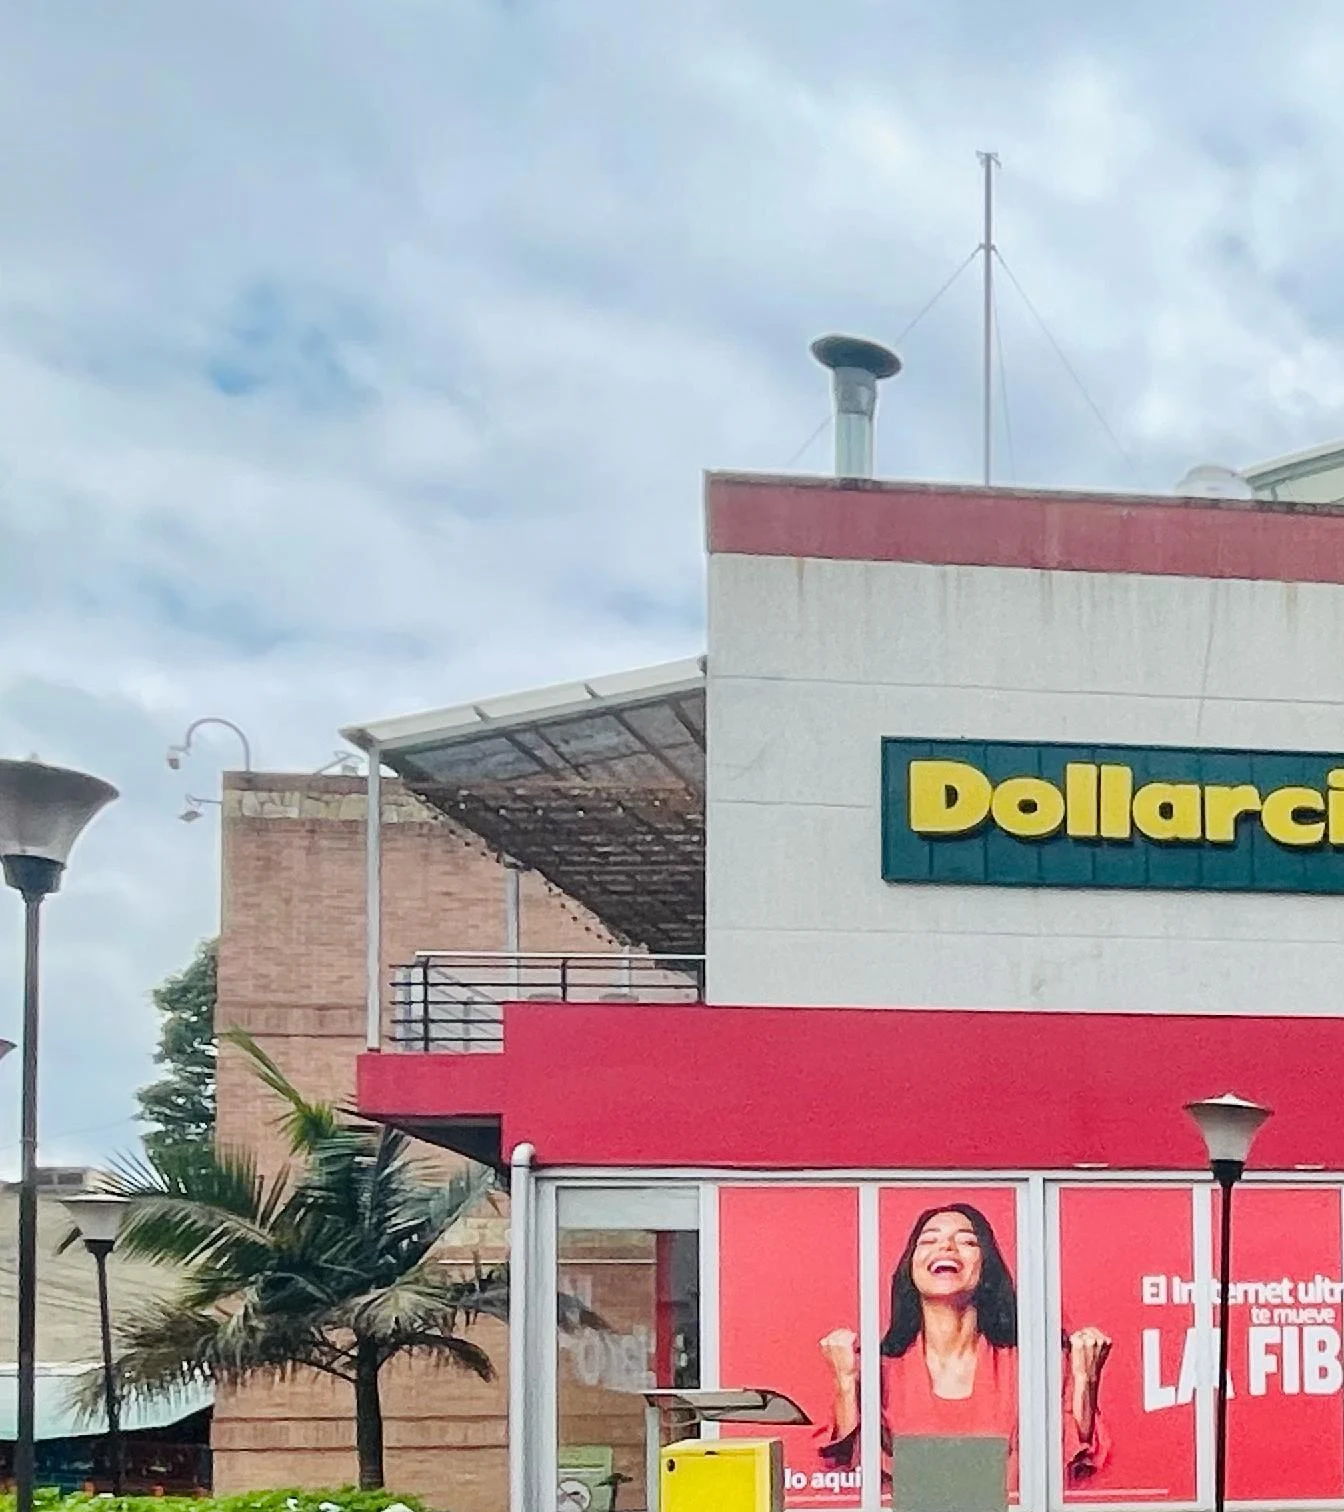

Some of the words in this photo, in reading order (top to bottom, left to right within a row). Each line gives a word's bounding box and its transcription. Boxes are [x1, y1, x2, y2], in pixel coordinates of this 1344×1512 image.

[1142, 1275, 1166, 1304] El
[1250, 1306, 1270, 1324] te
[1273, 1306, 1336, 1324] mueve
[1142, 1327, 1236, 1412] LA
